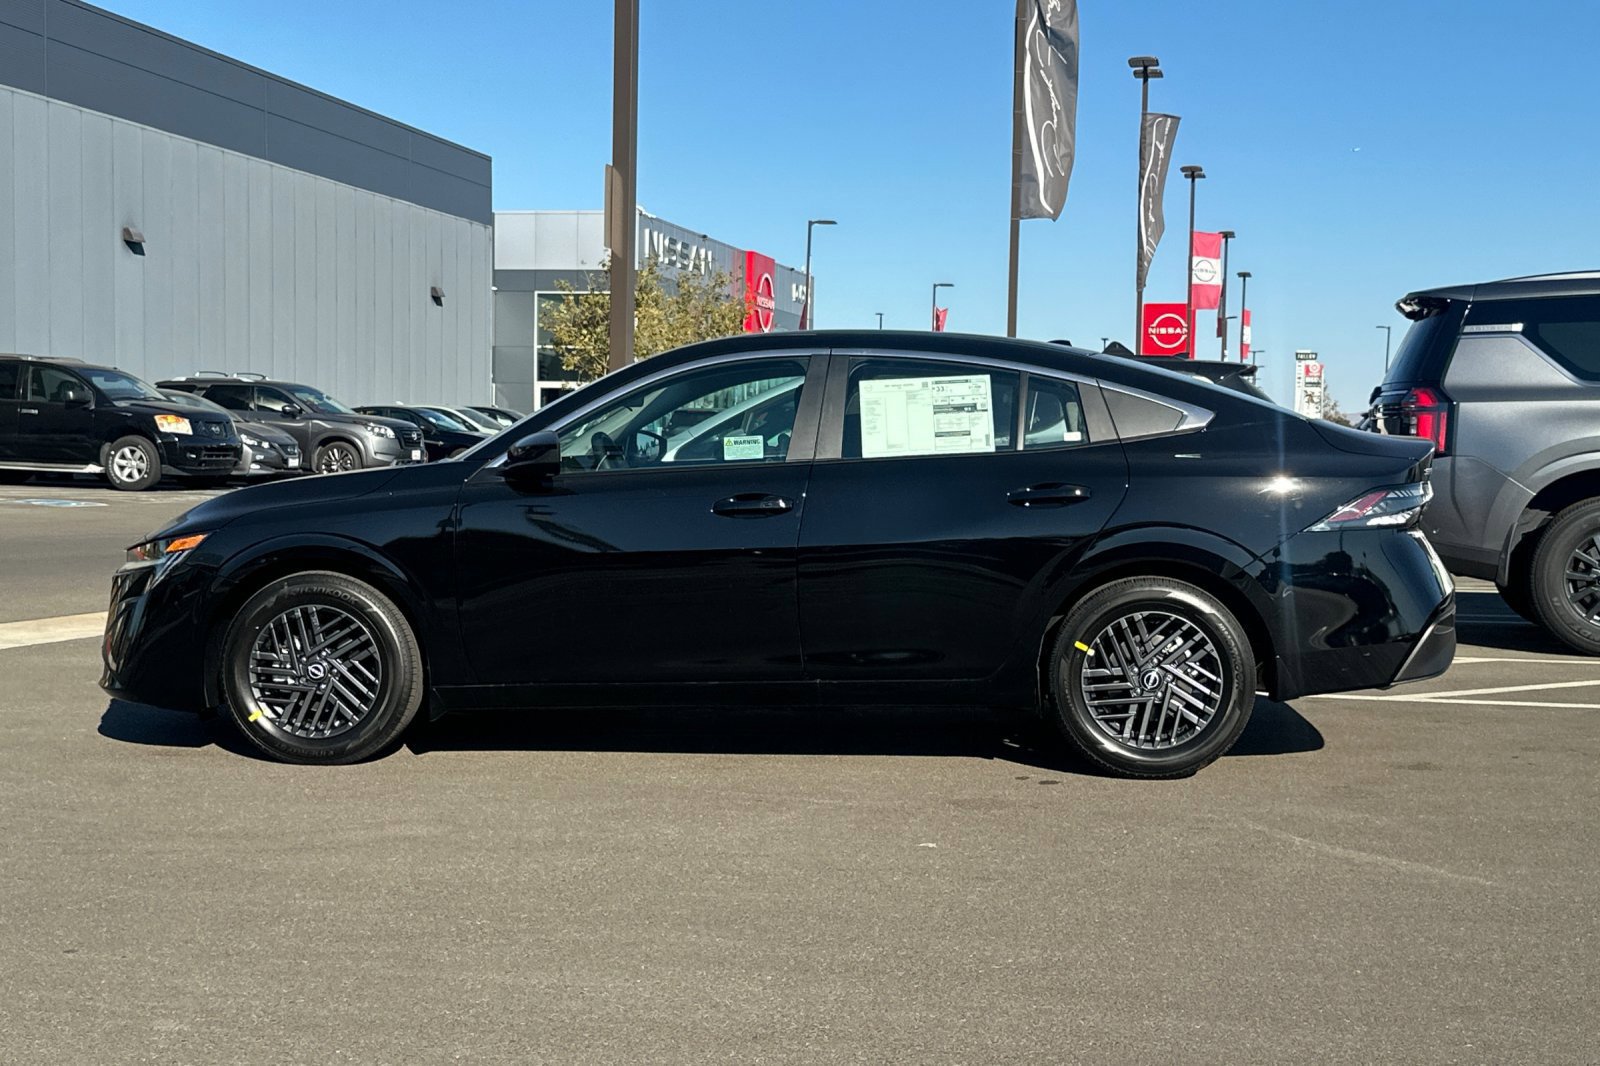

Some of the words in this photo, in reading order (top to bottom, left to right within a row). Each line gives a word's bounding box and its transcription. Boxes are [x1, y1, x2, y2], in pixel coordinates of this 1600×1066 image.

[644, 228, 713, 276] NISSAN
[1148, 326, 1188, 335] NISSAN
[733, 438, 761, 446] WARNING
